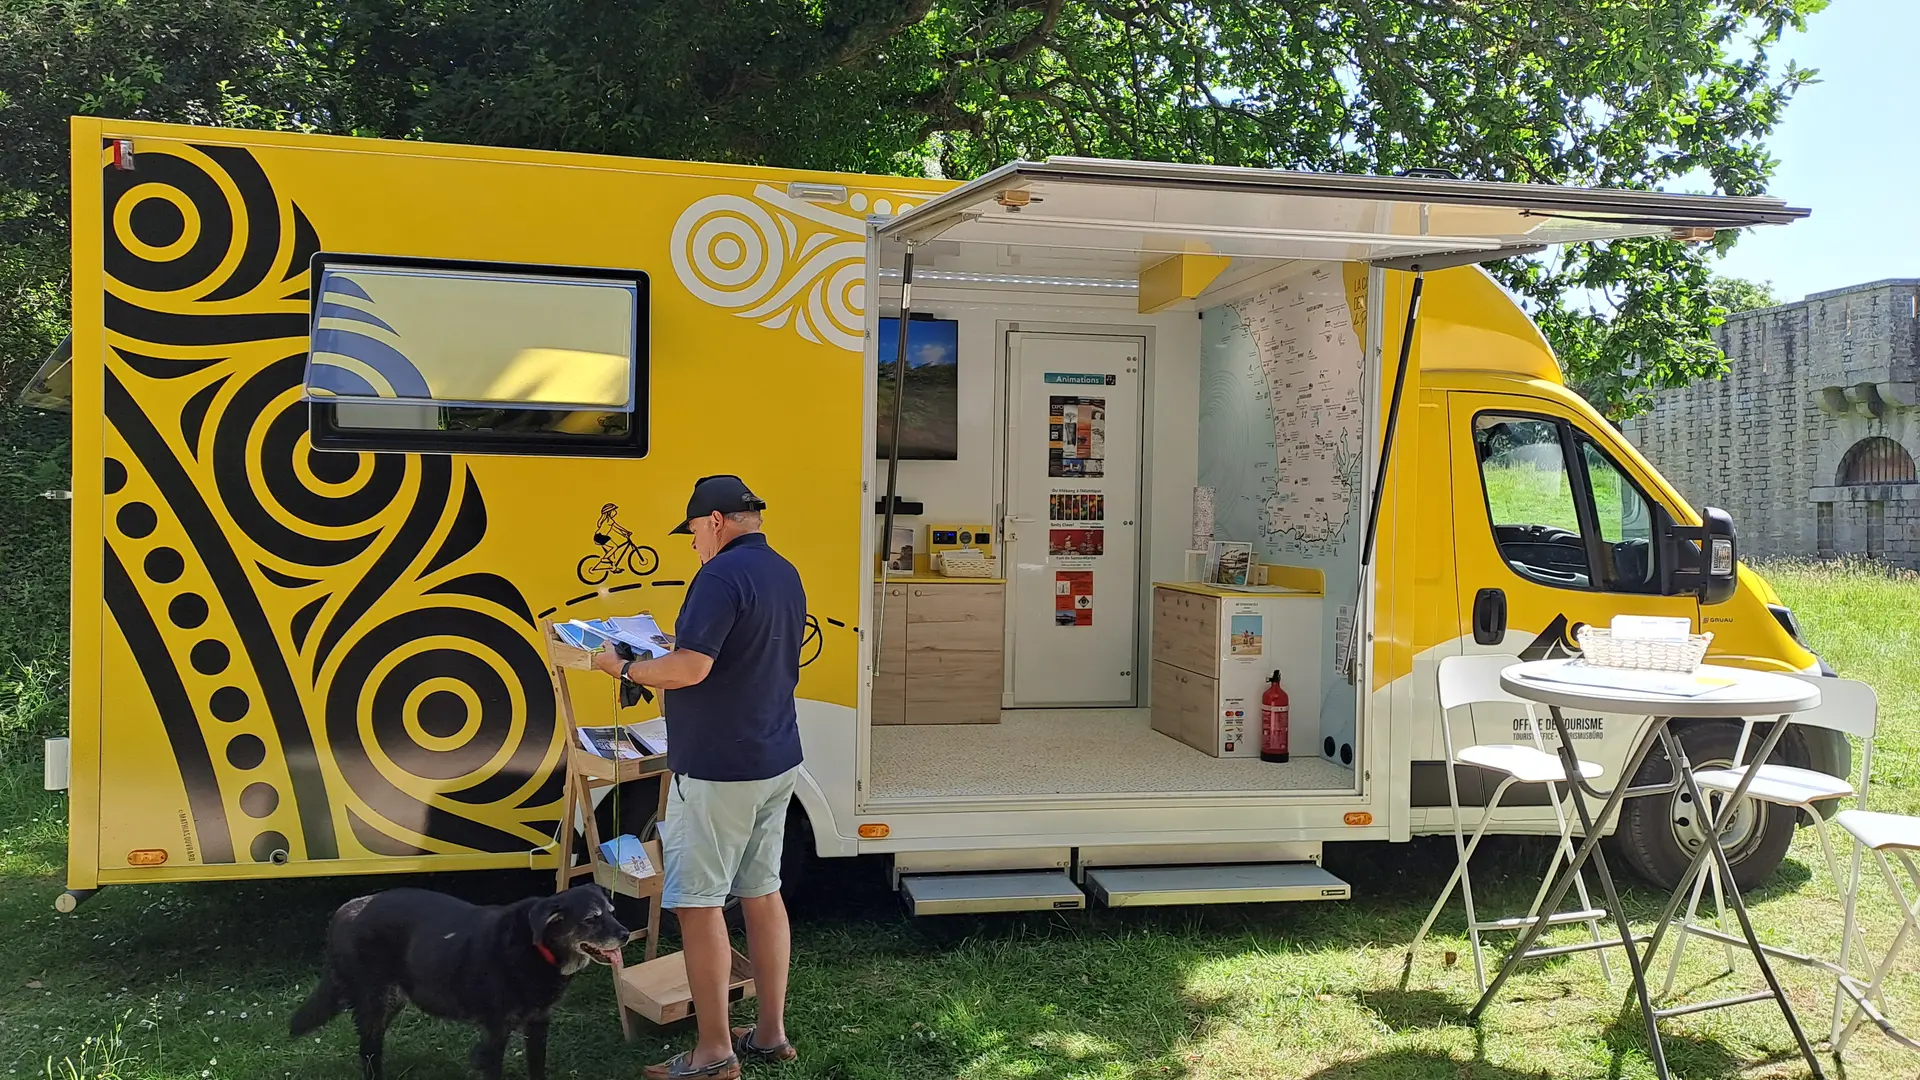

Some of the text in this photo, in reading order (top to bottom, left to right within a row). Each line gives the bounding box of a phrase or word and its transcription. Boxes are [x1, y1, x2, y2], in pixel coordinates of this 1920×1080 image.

[1056, 375, 1100, 384] Animations
[1512, 718, 1544, 731] OFFIE
[1561, 717, 1604, 730] OURISME
